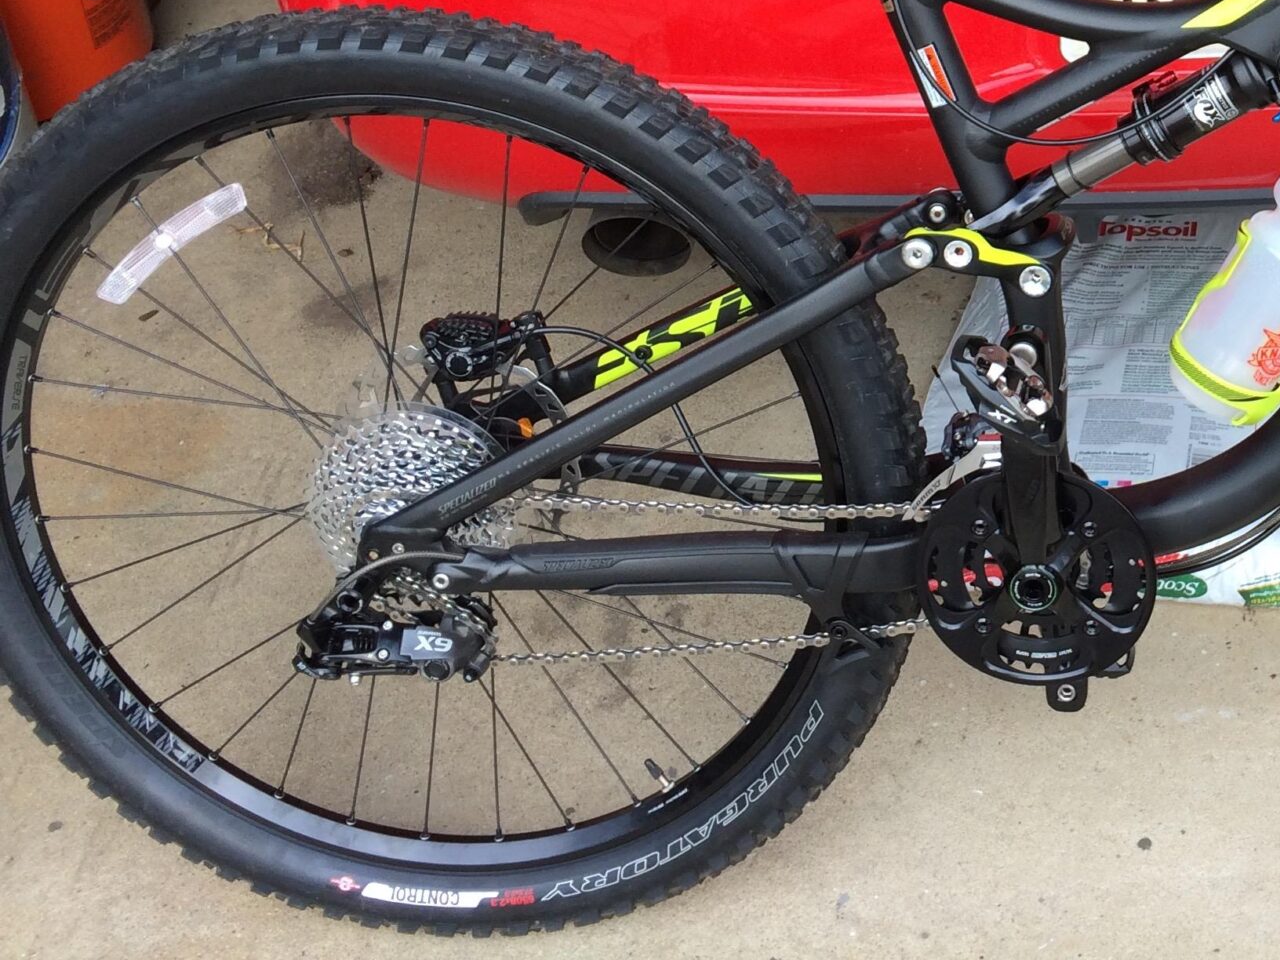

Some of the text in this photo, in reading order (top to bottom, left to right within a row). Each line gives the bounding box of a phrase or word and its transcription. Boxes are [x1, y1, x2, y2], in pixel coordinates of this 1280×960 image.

[1098, 221, 1199, 242] Topsoil
[437, 477, 498, 515] SPECIALIZED
[413, 635, 453, 653] X9
[541, 698, 825, 901] PURGATORY
[389, 886, 460, 906] CONTROL
